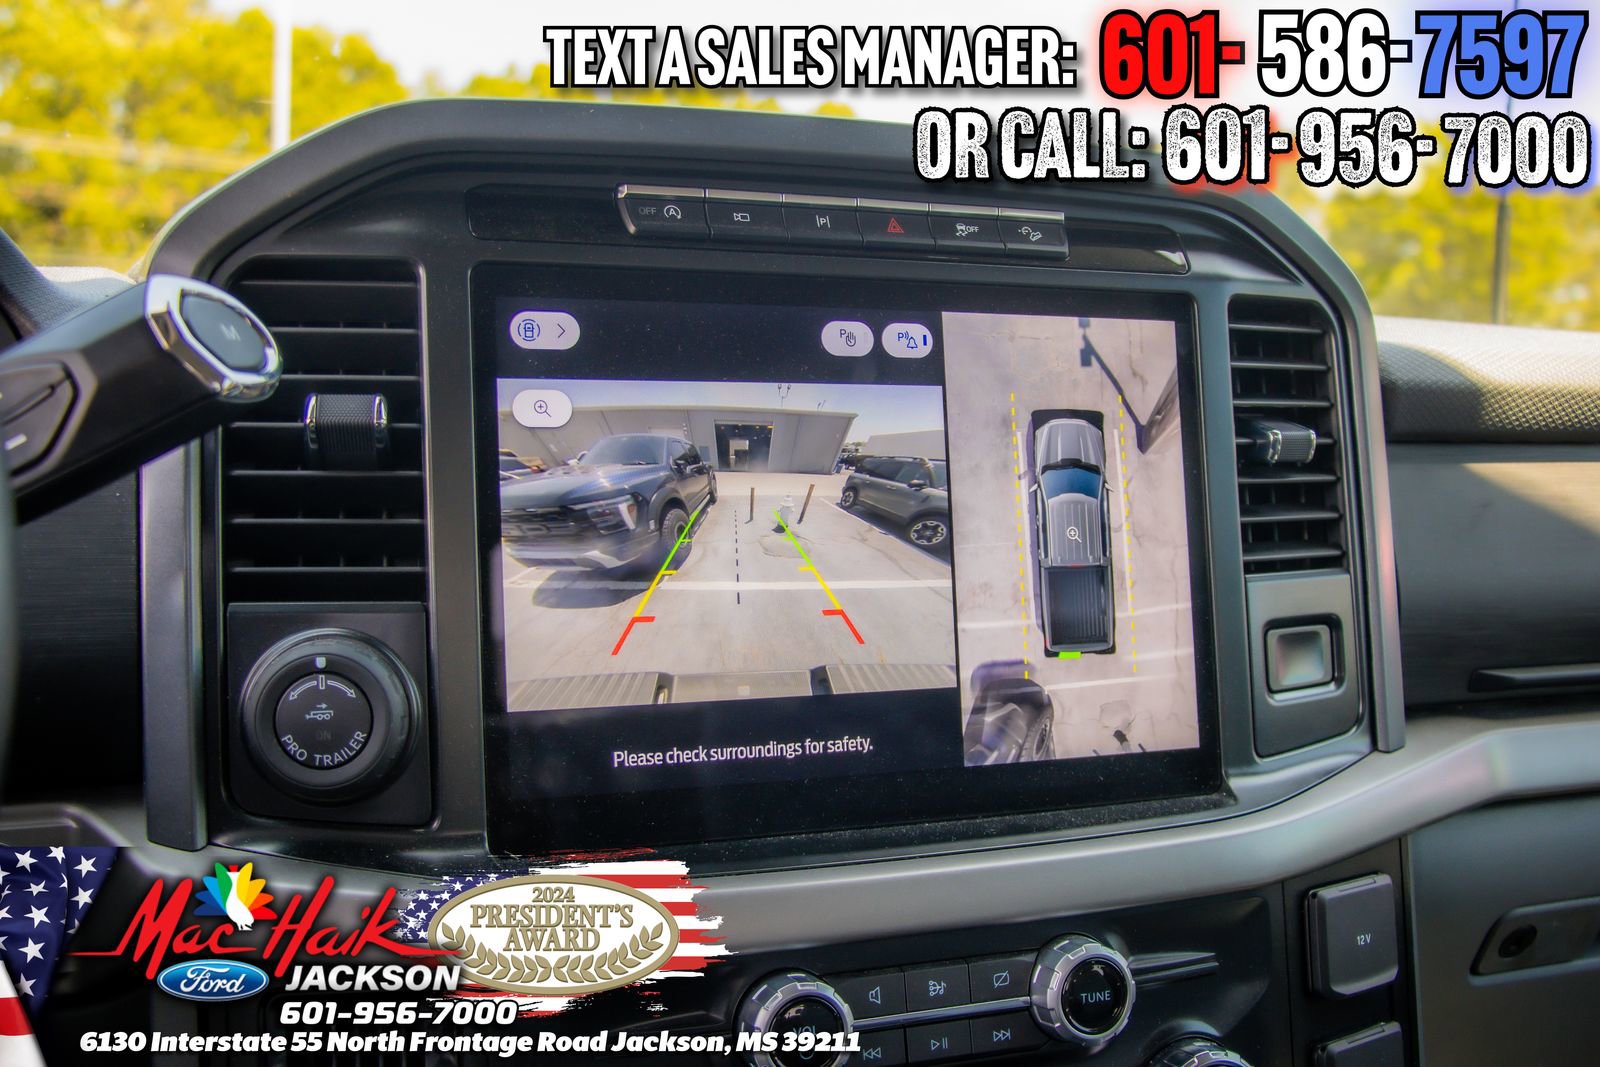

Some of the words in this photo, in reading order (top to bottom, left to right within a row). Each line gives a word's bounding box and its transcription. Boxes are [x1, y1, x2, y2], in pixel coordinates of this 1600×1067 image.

[966, 225, 979, 233] OFF
[281, 734, 308, 762] PRO
[313, 730, 367, 766] TRAILER
[613, 750, 663, 768] Please
[665, 746, 708, 764] check
[710, 740, 802, 761] surroundings
[804, 738, 825, 755] for
[826, 736, 874, 754] safety.
[1080, 990, 1112, 1004] TUNE
